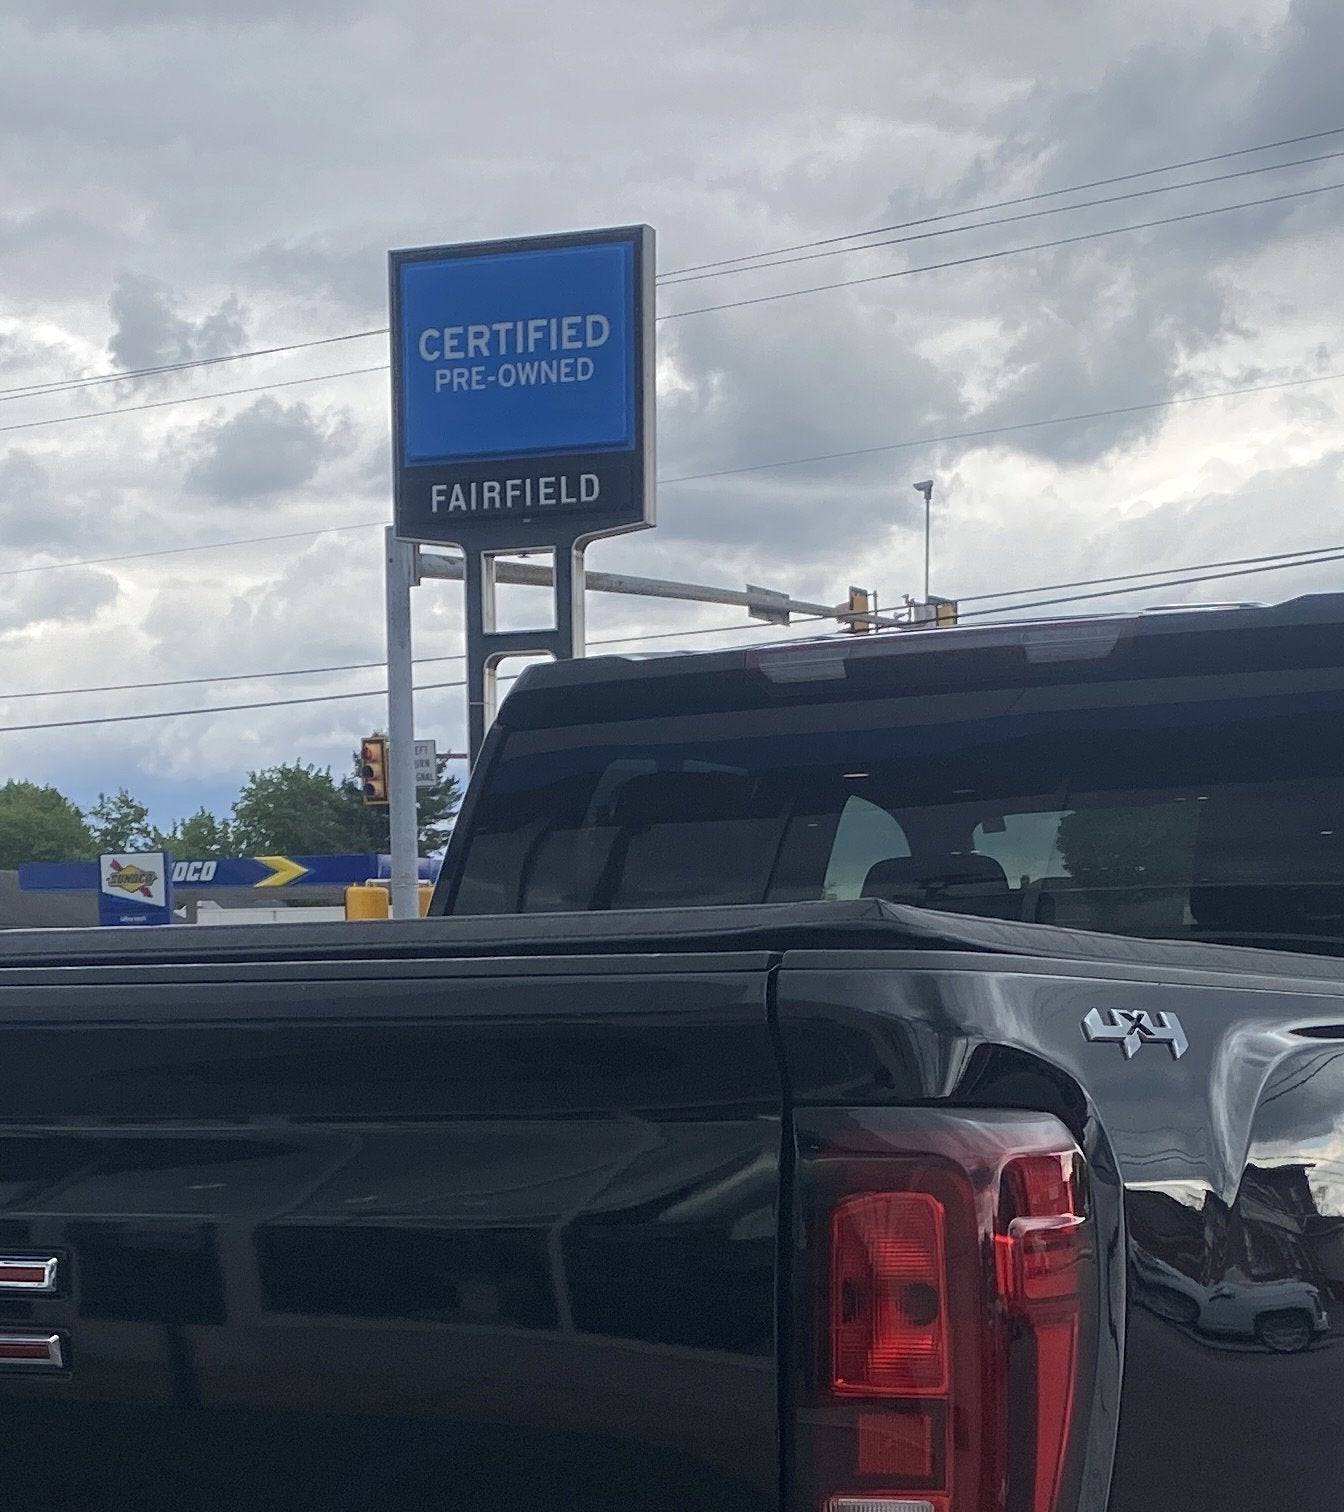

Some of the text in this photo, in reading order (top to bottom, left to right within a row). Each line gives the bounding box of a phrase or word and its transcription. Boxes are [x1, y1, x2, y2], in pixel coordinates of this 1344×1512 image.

[418, 314, 610, 362] CERTIFIED
[434, 357, 595, 393] PRE-OWNED
[431, 473, 600, 513] FAIRFIELD
[110, 872, 155, 885] SUNOCO
[171, 861, 218, 882] OCO
